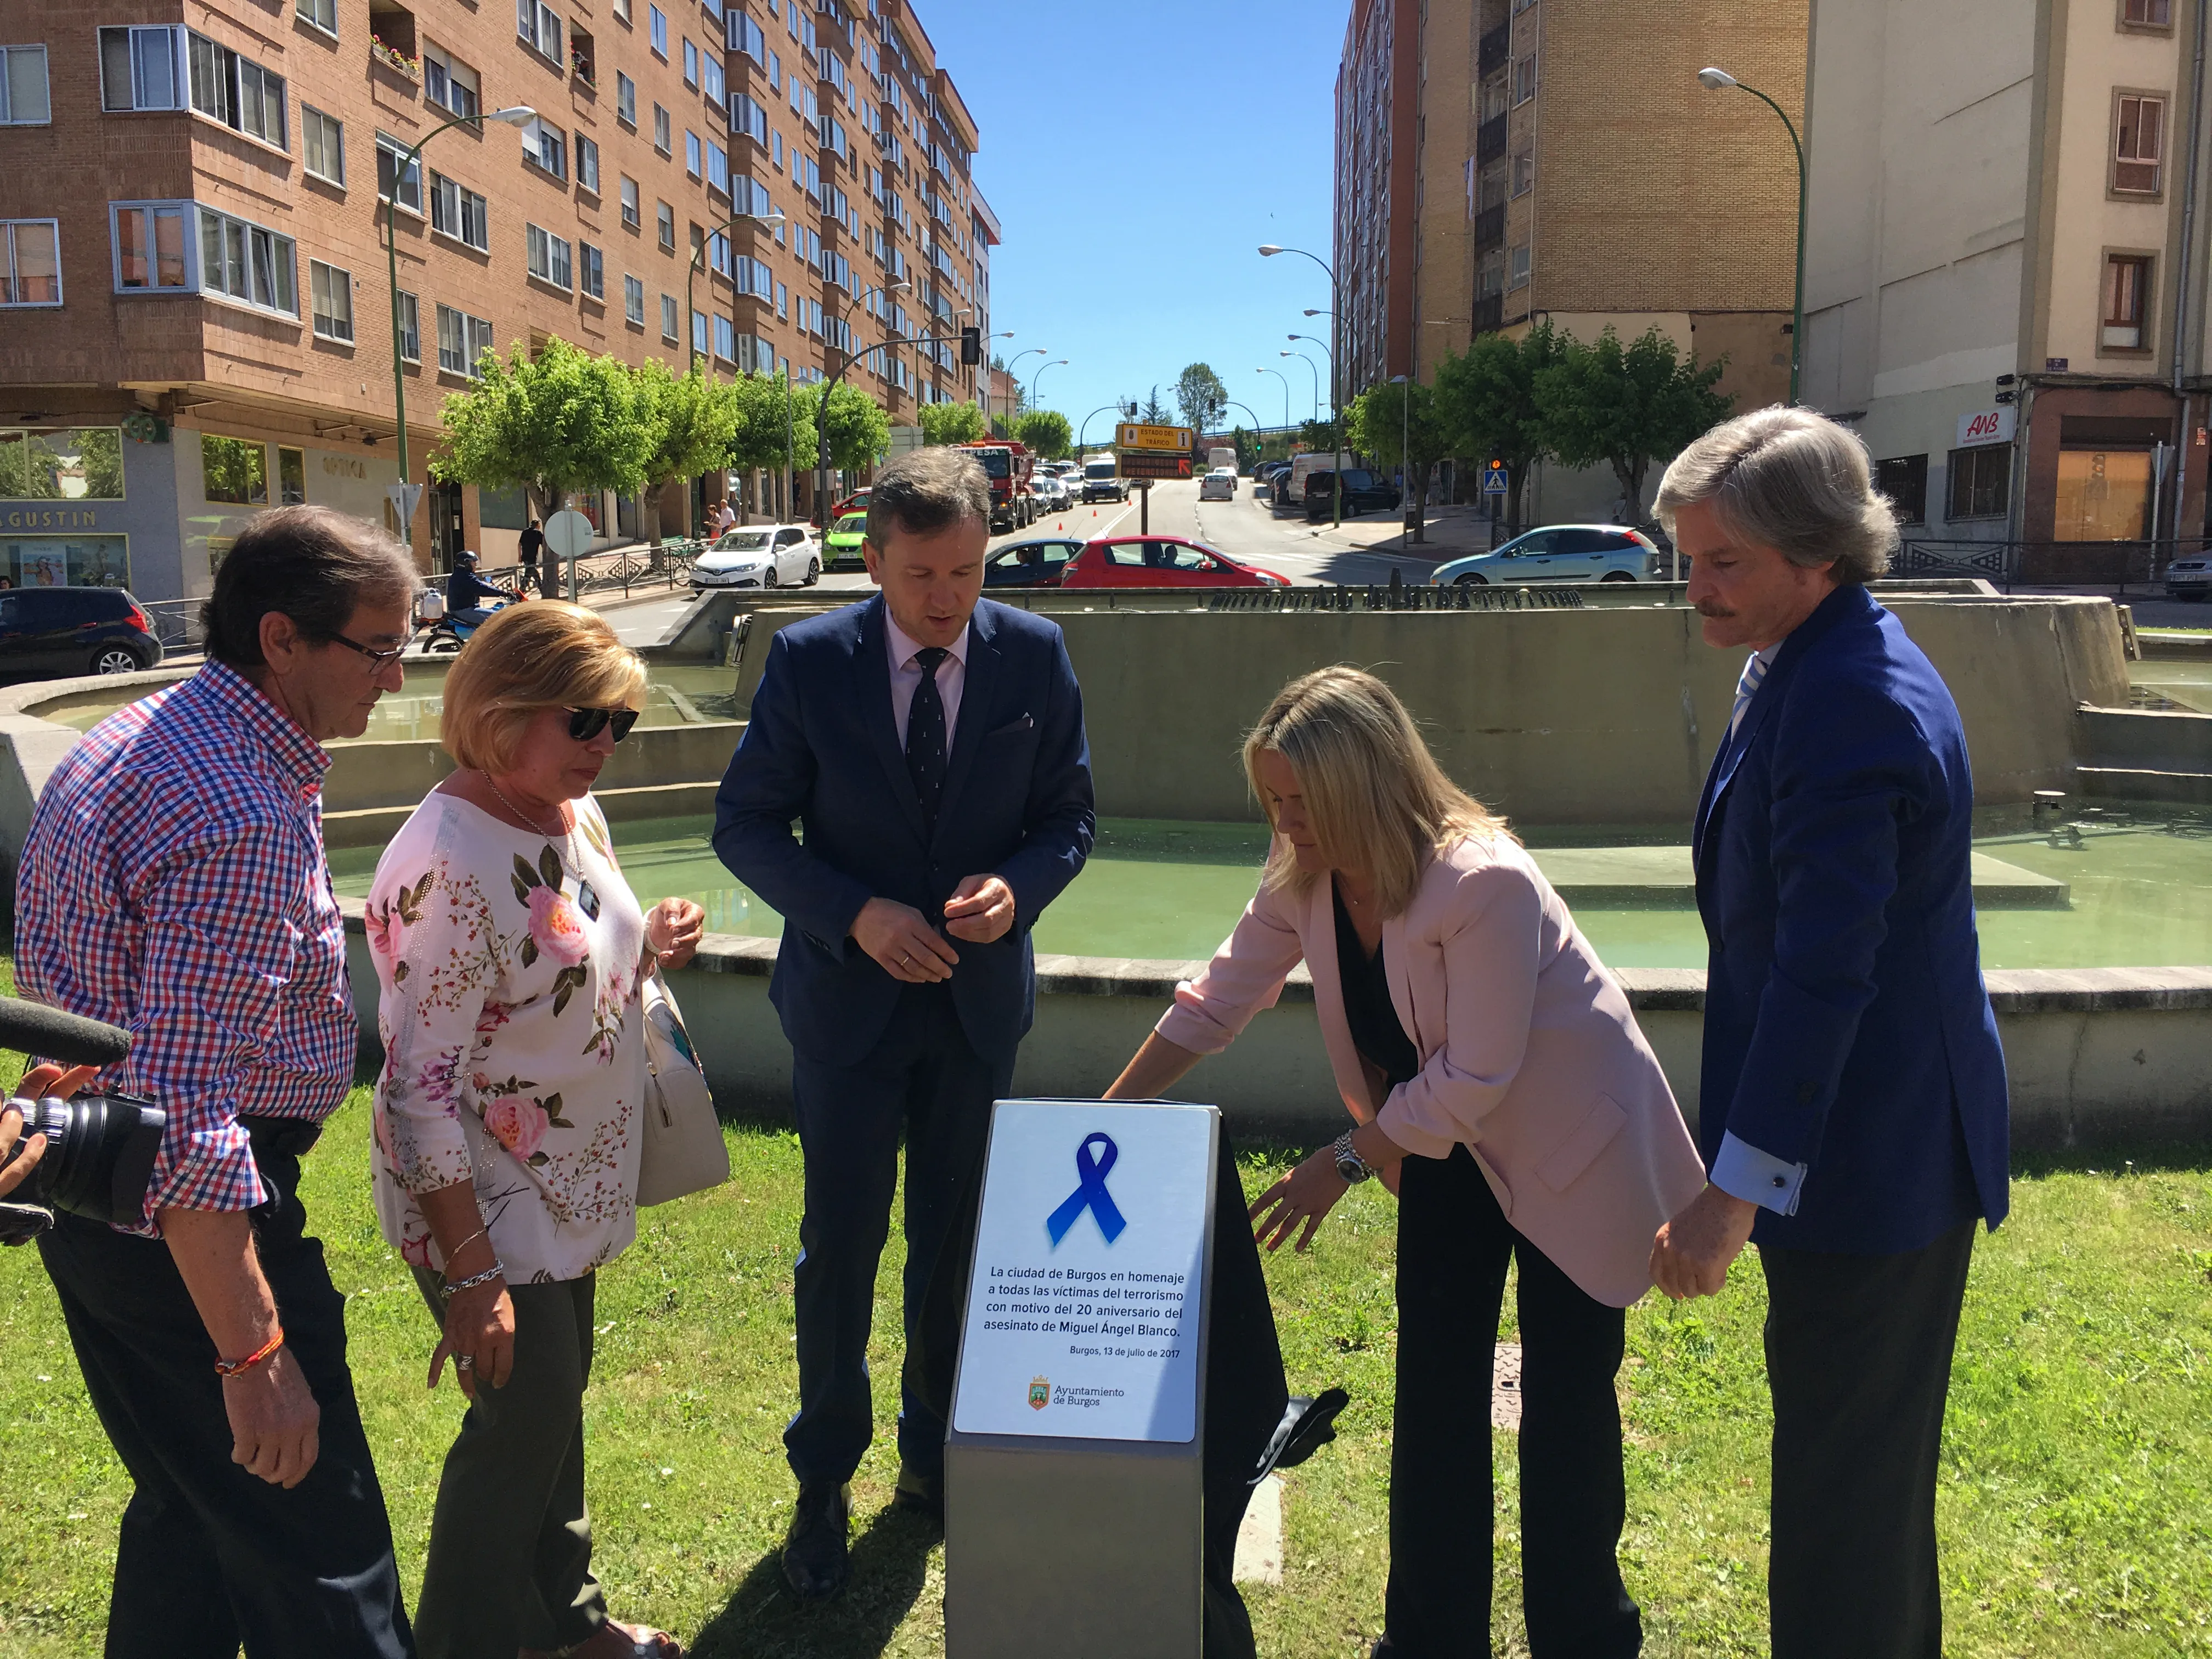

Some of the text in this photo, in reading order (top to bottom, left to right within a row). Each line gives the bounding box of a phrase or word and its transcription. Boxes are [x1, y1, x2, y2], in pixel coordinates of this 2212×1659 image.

[0, 511, 96, 527] GUSTIN
[990, 1266, 1184, 1286] La ciudad de Burgos en homenaje
[988, 1284, 1183, 1301] a todas las víctimas del terrorismo
[986, 1302, 1182, 1319] con motivo del 20 aniversario del
[984, 1319, 1180, 1338] asesinato de Miguel Ángel Blanco.
[1070, 1345, 1180, 1358] Burgos, 13 de julio de 2017
[1054, 1385, 1125, 1397] Ayuntamiento
[1053, 1395, 1100, 1408] de Burgos
